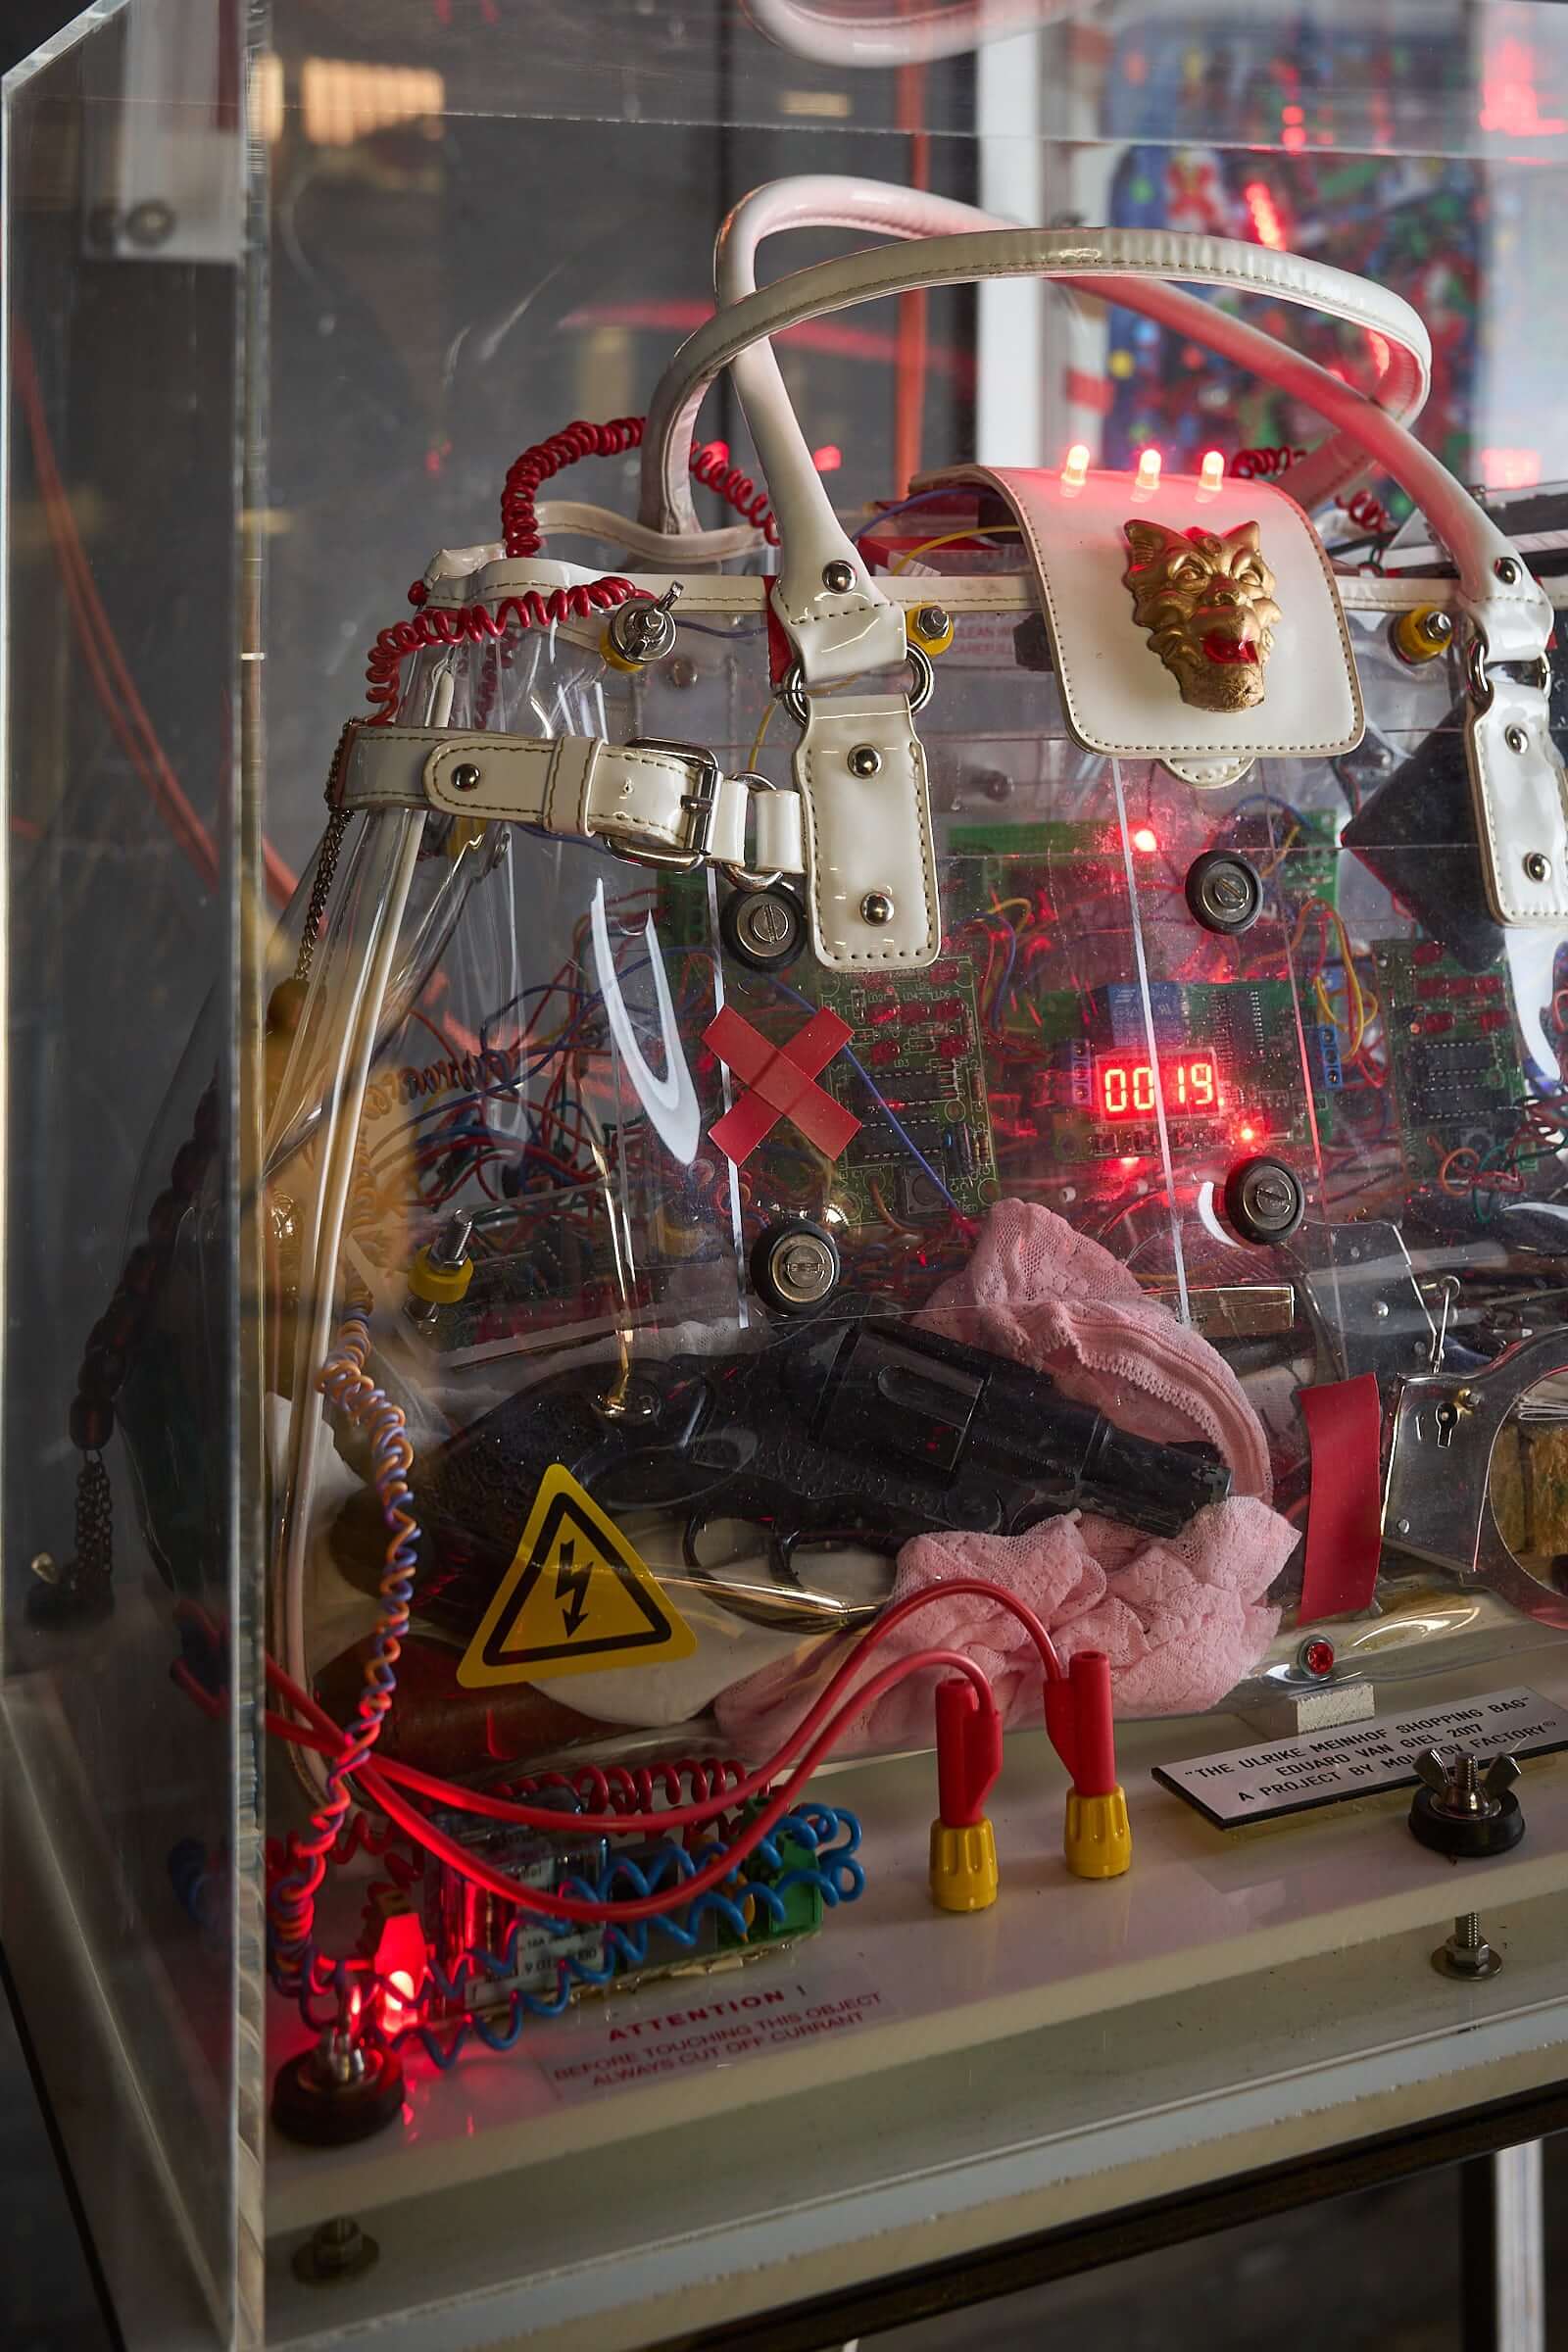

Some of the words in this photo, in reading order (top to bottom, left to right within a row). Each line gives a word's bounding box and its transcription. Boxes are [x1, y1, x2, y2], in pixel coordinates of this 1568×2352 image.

[1103, 1062, 1214, 1113] 0019
[1184, 1762, 1236, 1780] "THE
[1238, 1746, 1306, 1770] ULRIKE
[1308, 1728, 1389, 1753] MEINHOF
[1396, 1708, 1485, 1734] SHOPPING
[1487, 1696, 1531, 1714] BAG"
[1275, 1753, 1351, 1777] EDUARD
[1354, 1743, 1395, 1758] VAN
[1399, 1733, 1444, 1749] GIEL
[1446, 1723, 1484, 1739] 2017
[1238, 1791, 1255, 1802] A
[1258, 1771, 1344, 1796] PROJECT
[1348, 1763, 1374, 1777] BY
[1380, 1743, 1464, 1769] MOLTOV
[554, 2053, 637, 2082] BEFORE
[643, 2024, 754, 2058] TOUCHING
[754, 2012, 803, 2031] THIS
[805, 1990, 881, 2019] OBJECT
[609, 1989, 785, 2041] ATTENTION
[593, 2058, 675, 2086] ALWAYS
[678, 2045, 720, 2064] CUT
[725, 2035, 764, 2054] OFF
[769, 2011, 864, 2042] CURRANT
